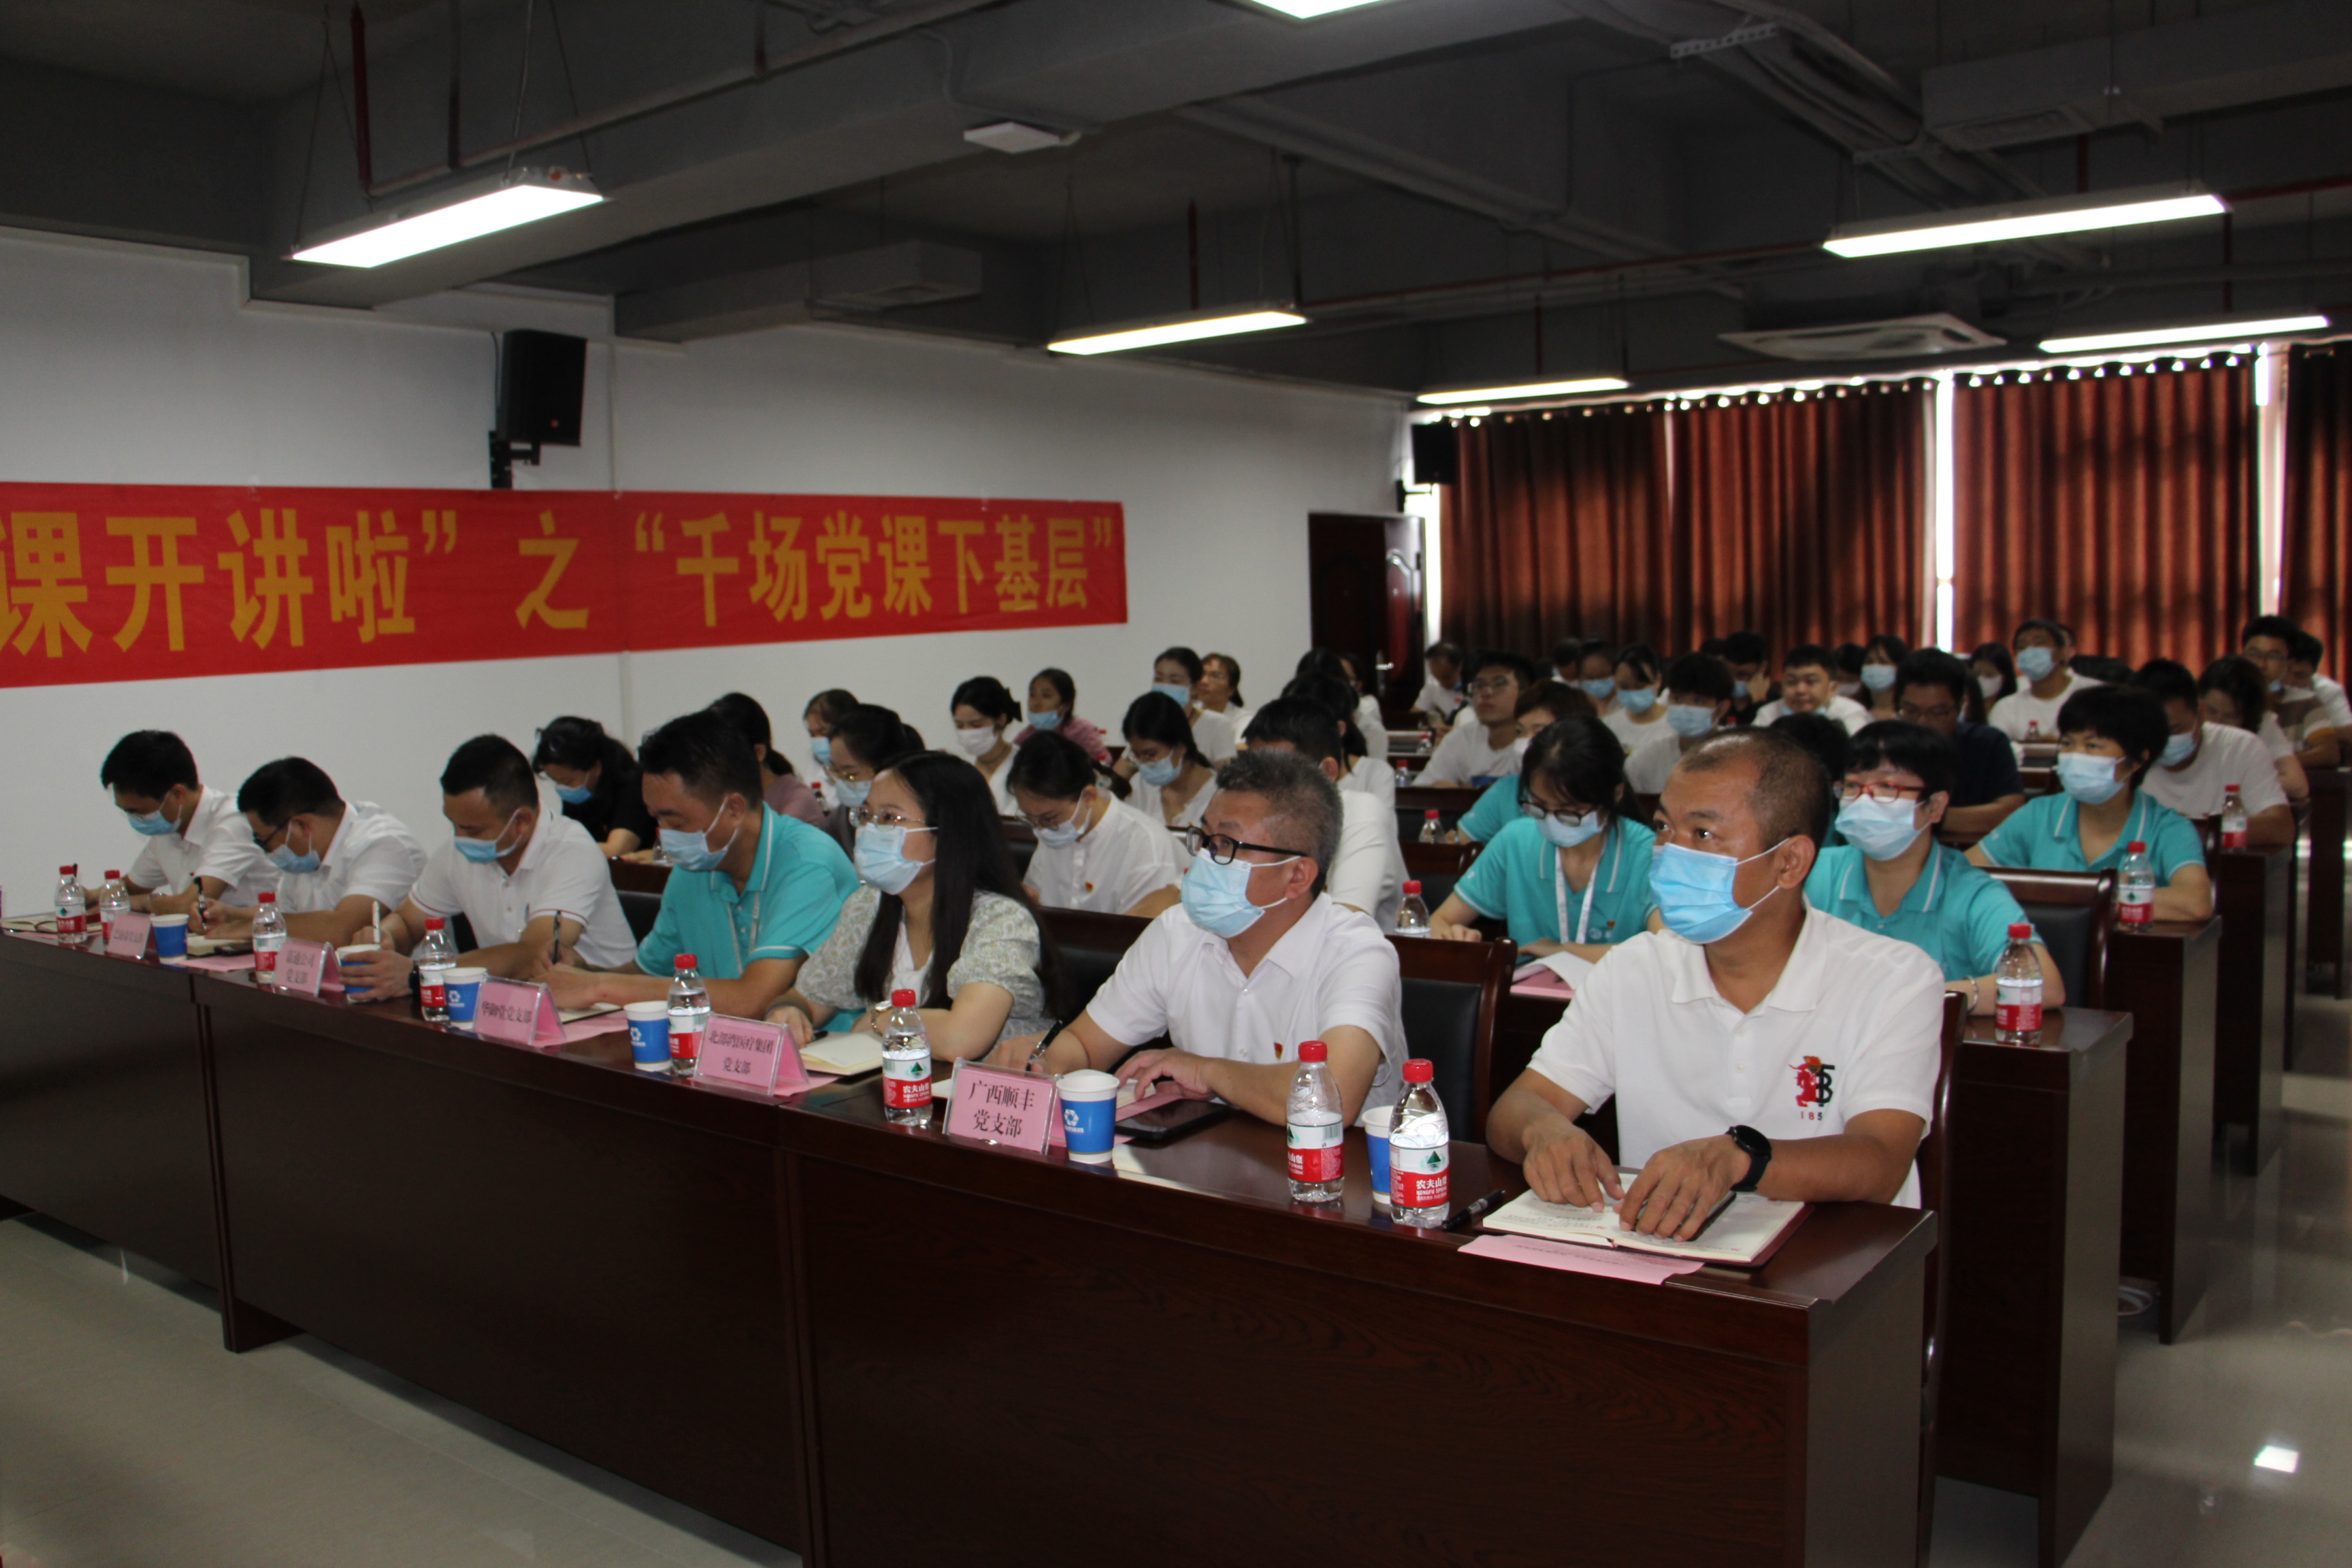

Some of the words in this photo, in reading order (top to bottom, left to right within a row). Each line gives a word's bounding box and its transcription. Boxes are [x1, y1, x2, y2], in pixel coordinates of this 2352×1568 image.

[723, 1057, 751, 1075] 党支部
[968, 1079, 1035, 1111] 广西顺丰
[973, 1109, 1023, 1138] 党支部
